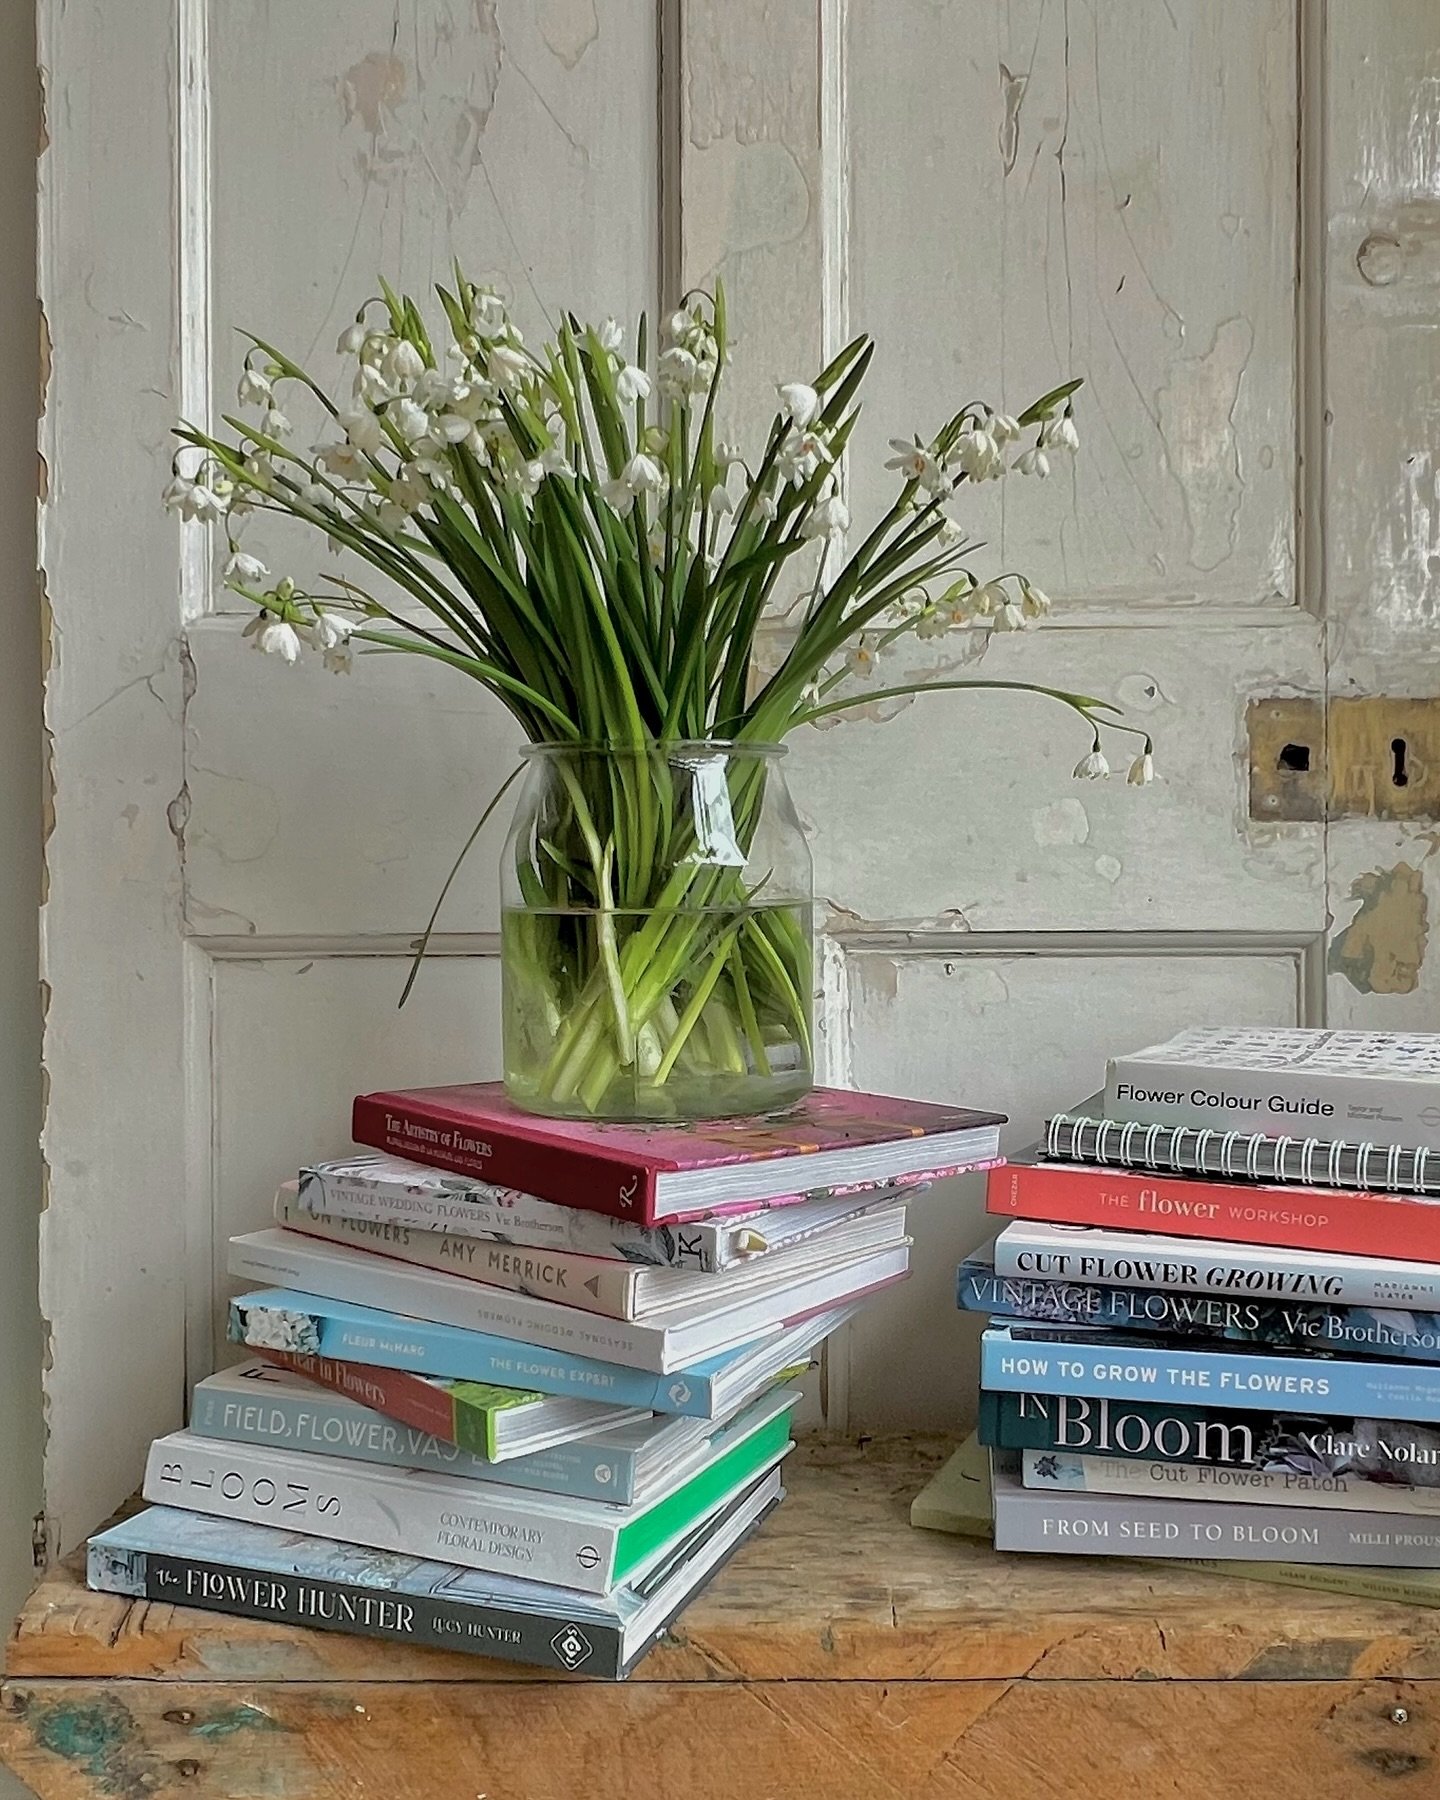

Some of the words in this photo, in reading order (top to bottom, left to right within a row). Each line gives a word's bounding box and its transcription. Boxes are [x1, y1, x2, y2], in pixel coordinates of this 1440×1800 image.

[1117, 1084, 1184, 1104] Flower
[1191, 1090, 1261, 1111] Colour
[1268, 1096, 1335, 1117] Guide
[453, 1130, 493, 1157] FLOWERS
[330, 1189, 376, 1208] VINTAGE
[377, 1193, 433, 1215] WEDDING
[437, 1204, 491, 1223] FLOWERS
[1099, 1192, 1130, 1208] THE
[1138, 1189, 1220, 1220] flower
[1229, 1206, 1329, 1227] WORKSHOP
[440, 1239, 476, 1263] AMY
[488, 1251, 568, 1288] MERRICK
[1017, 1252, 1071, 1275] CUT
[1080, 1257, 1198, 1285] FLOWER
[1206, 1267, 1344, 1297] GROWING
[969, 1276, 1100, 1315] VINTAGE
[1109, 1290, 1260, 1331] FLOWERS
[1282, 1311, 1320, 1337] Vic
[342, 1334, 376, 1348] FLEUR
[489, 1357, 512, 1371] THE
[517, 1361, 566, 1380] FLOWER
[1002, 1357, 1048, 1376] HOW
[1057, 1361, 1084, 1378] TO
[1094, 1364, 1157, 1383] GROW
[1166, 1368, 1210, 1387] THE
[1220, 1373, 1330, 1395] FLOWERS
[336, 1361, 386, 1406] Flowers
[223, 1404, 292, 1438] FIELD,
[296, 1413, 405, 1454] FLOWER,
[1019, 1393, 1048, 1419] IN
[1054, 1396, 1257, 1465] Bloom
[1309, 1433, 1371, 1458] Clare
[160, 1463, 342, 1517] BLOOMS
[1102, 1462, 1141, 1480] The
[1150, 1464, 1189, 1482] Cut
[1197, 1468, 1274, 1488] Flower
[1284, 1473, 1349, 1493] Patch
[437, 1530, 484, 1553] FLORAL
[489, 1541, 535, 1562] DESIGN
[440, 1511, 545, 1544] CONTEMPORARY
[1042, 1519, 1109, 1537] FROM
[1120, 1521, 1179, 1539] SEED
[1190, 1524, 1222, 1541] TO
[1232, 1525, 1319, 1544] BLOOM
[1349, 1532, 1390, 1545] MILLI
[156, 1569, 182, 1587] the
[186, 1569, 286, 1611] FLOWER
[298, 1587, 414, 1632] HUNTER
[467, 1623, 522, 1644] HUNTER
